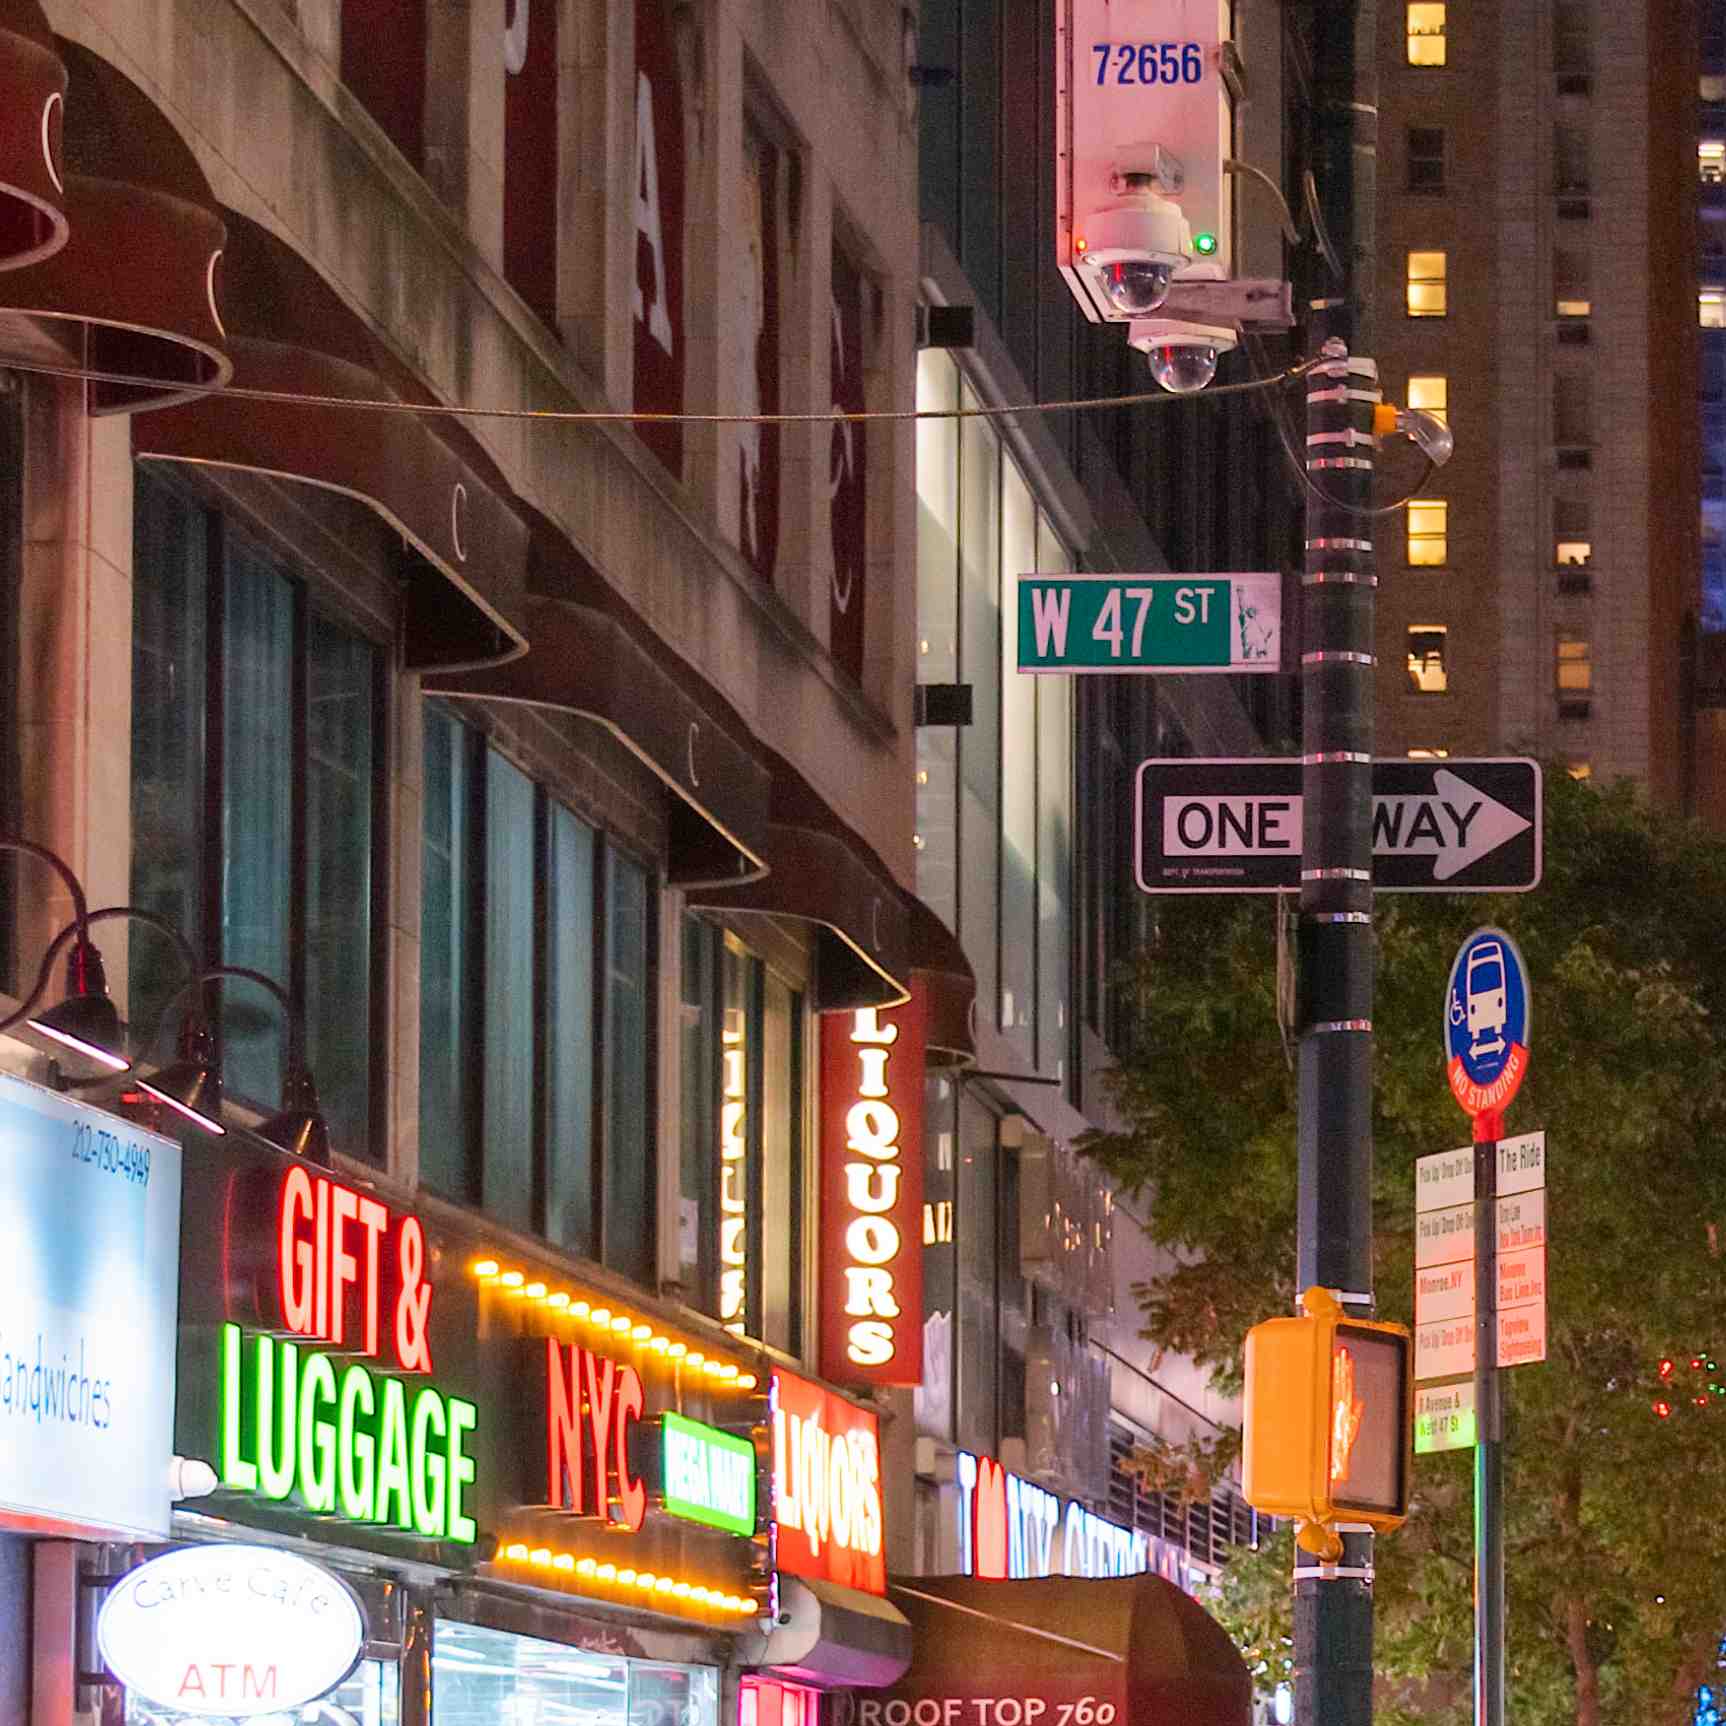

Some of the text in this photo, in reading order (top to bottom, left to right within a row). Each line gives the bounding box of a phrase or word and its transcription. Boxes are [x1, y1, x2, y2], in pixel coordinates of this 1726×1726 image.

[1093, 43, 1202, 85] 7-2656
[1031, 588, 1214, 658] W 47 ST
[1178, 801, 1482, 849] ONE WAY
[1454, 1056, 1520, 1109] NO STANDING
[844, 1006, 901, 1367] LIQUORS
[1500, 1143, 1542, 1174] The Ride
[279, 1164, 433, 1374] GIFT &
[0, 1335, 112, 1429] andwiches
[220, 1321, 478, 1545] LUGGAGE
[547, 1336, 647, 1533] NYC
[775, 1409, 884, 1558] LIQUORS
[177, 1663, 277, 1699] ATM
